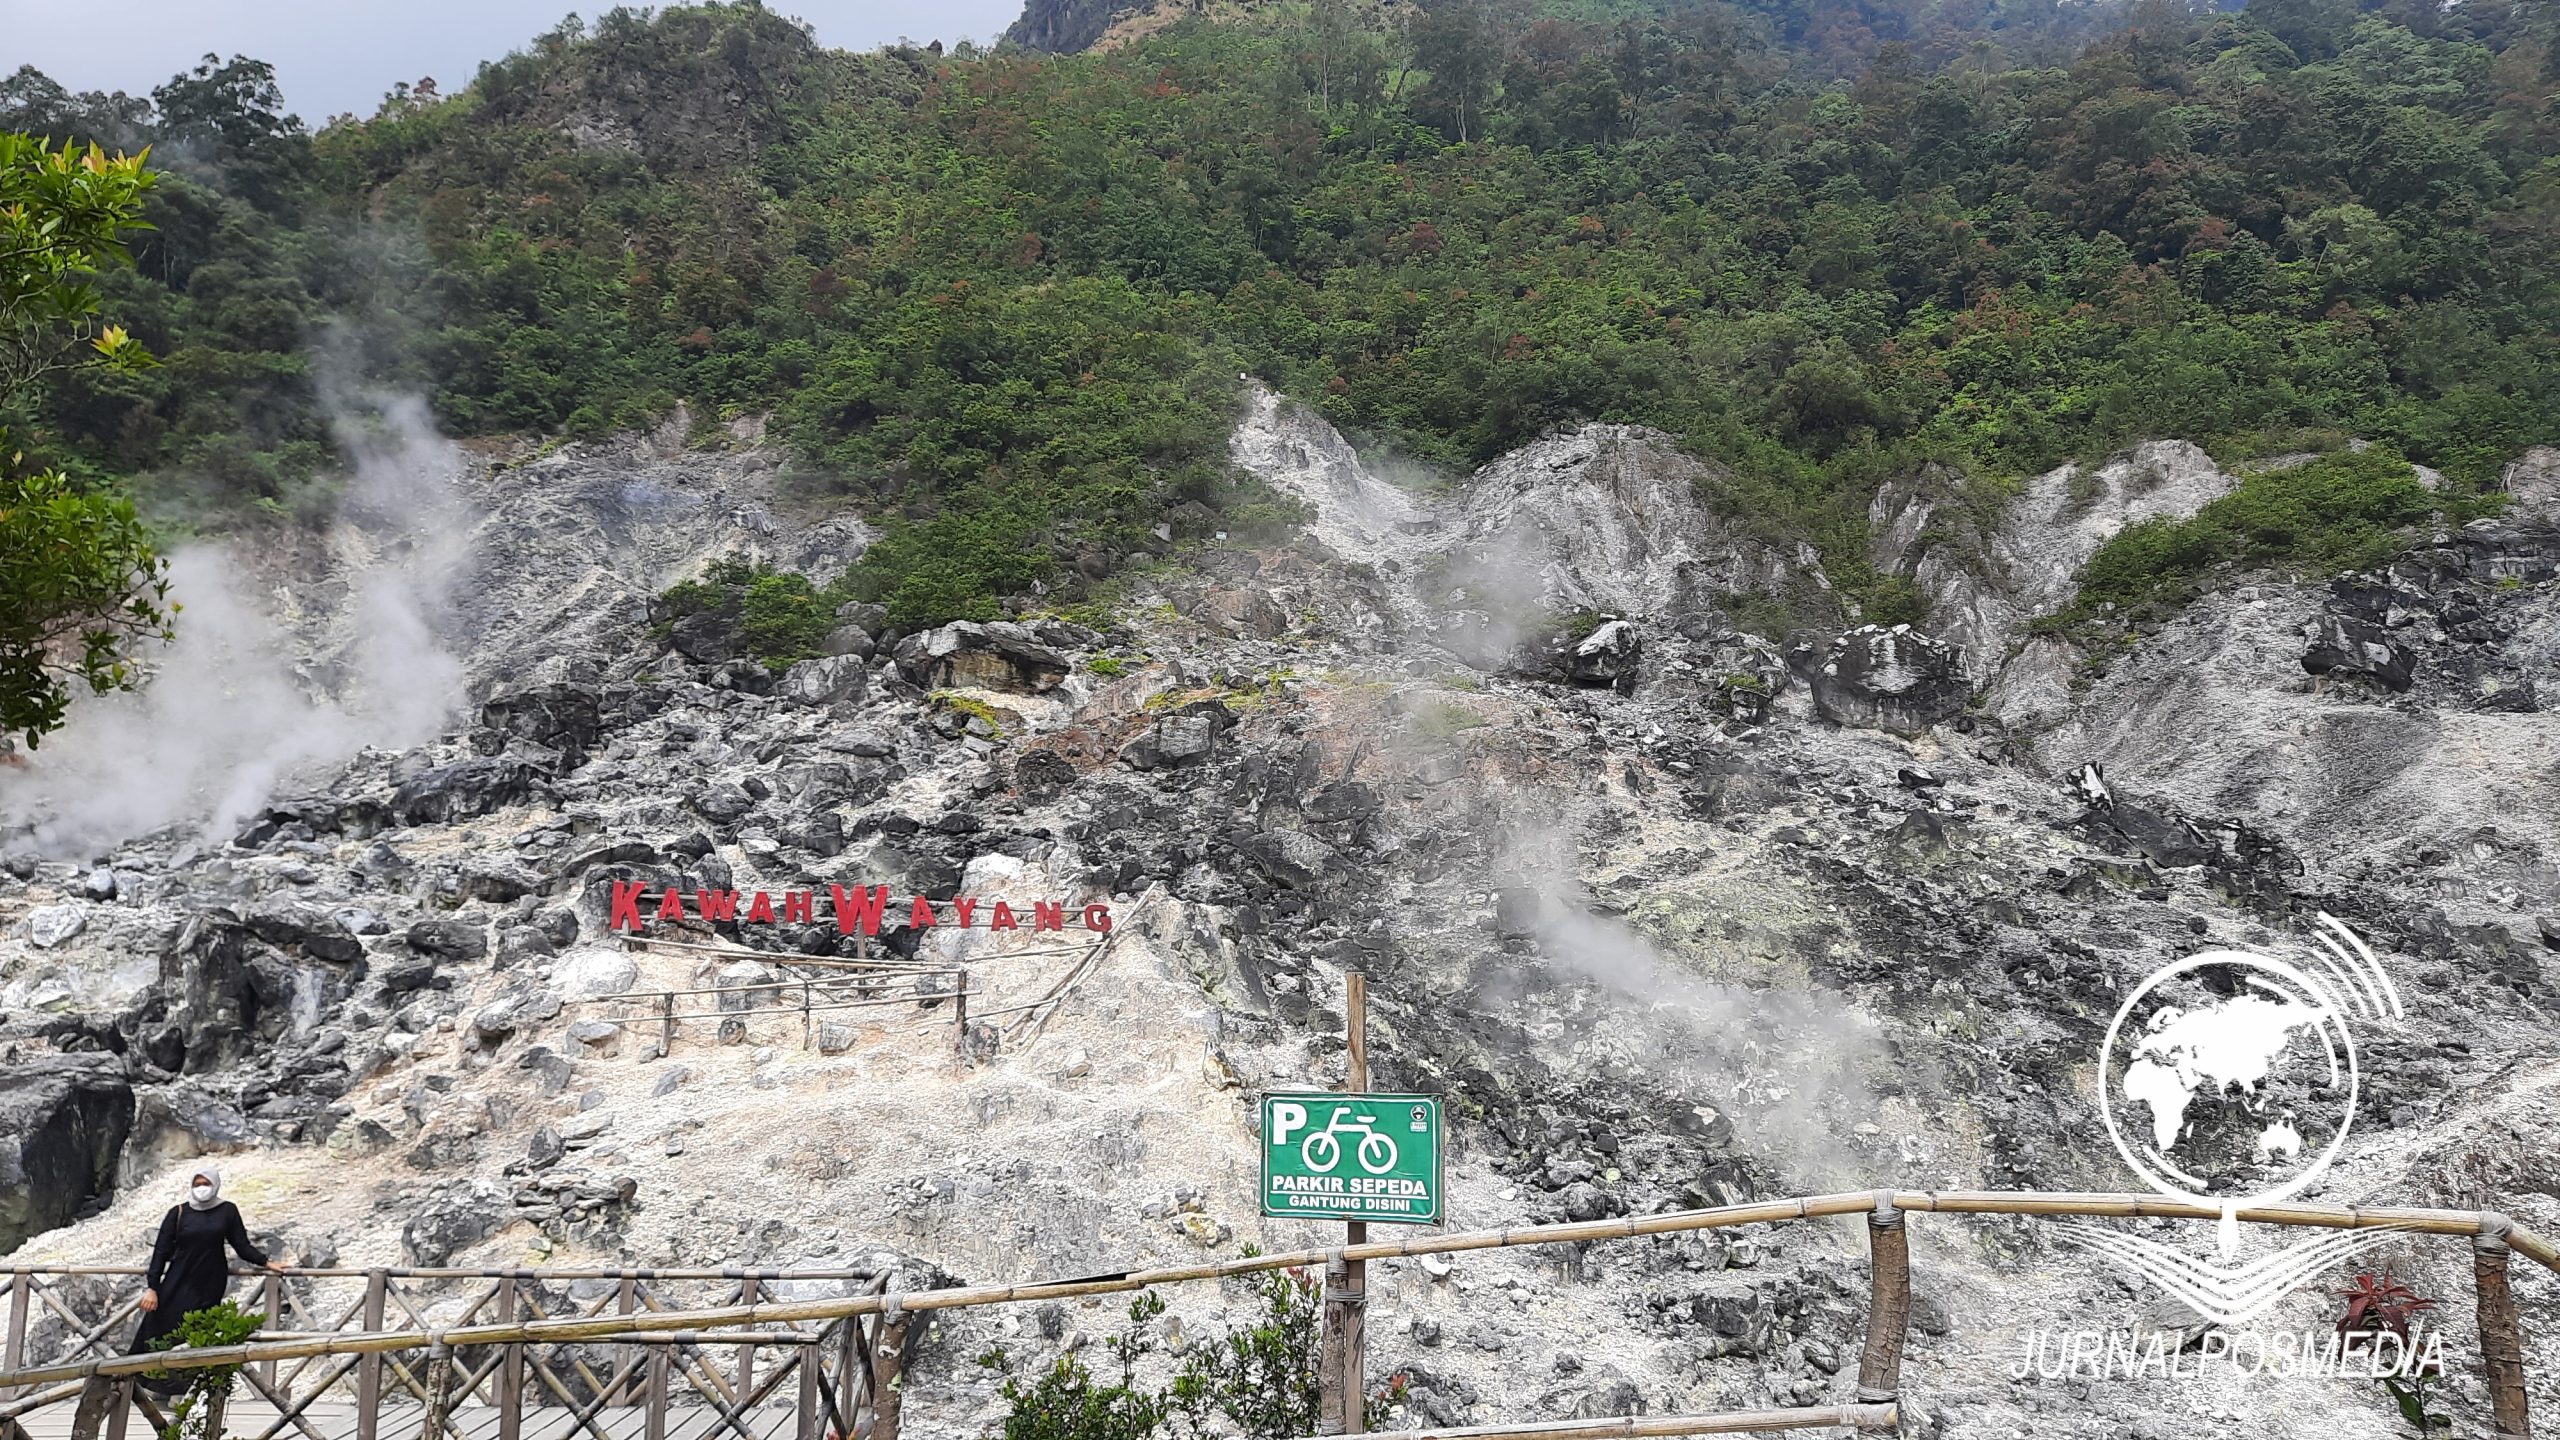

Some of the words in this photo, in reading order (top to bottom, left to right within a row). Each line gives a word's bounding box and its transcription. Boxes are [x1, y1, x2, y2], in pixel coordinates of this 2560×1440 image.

[610, 880, 812, 931] KAWAH
[831, 884, 1113, 936] WAYANG
[1272, 1102, 1307, 1145] P
[1272, 1175, 1343, 1192] PARKIR
[1349, 1178, 1426, 1195] SEPEDA
[1289, 1195, 1361, 1209] GANTUNG
[1365, 1199, 1411, 1212] DISINI
